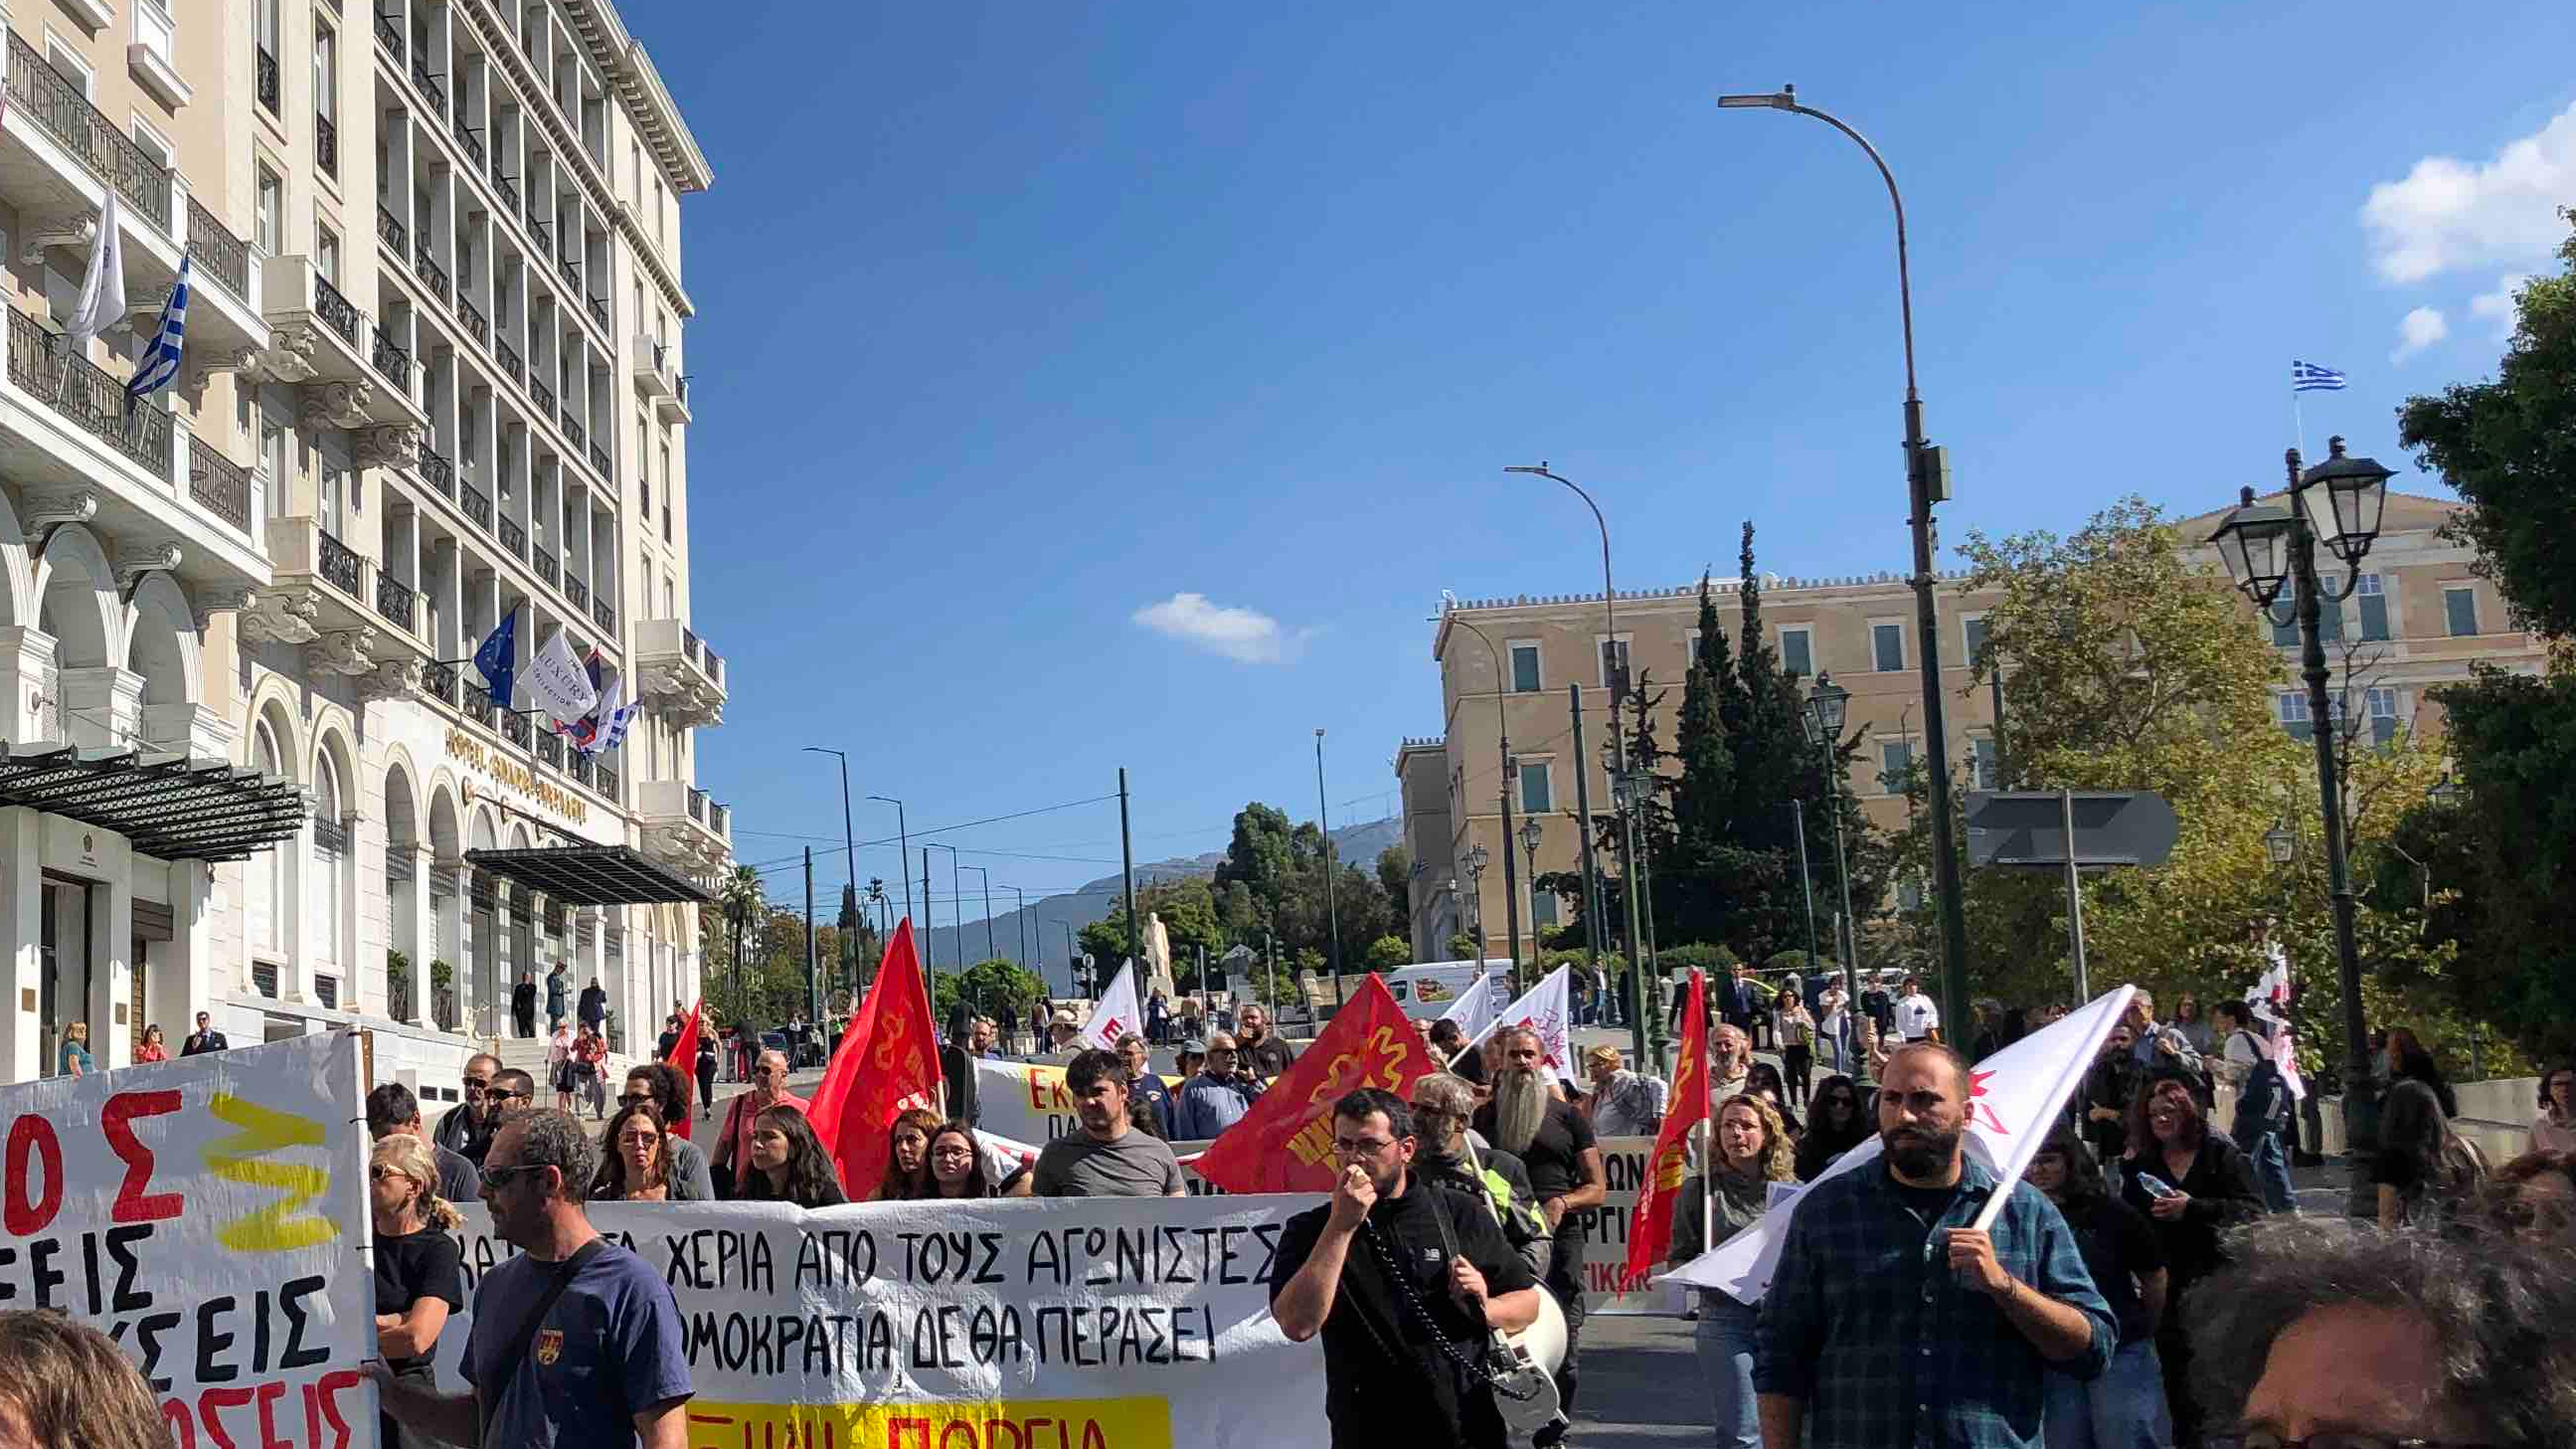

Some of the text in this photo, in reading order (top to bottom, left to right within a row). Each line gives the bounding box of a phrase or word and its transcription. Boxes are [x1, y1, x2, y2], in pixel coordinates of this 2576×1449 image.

[538, 651, 590, 702] LUXURY
[1599, 1153, 1645, 1191] ΩΝ
[665, 1229, 775, 1294] ΧΕΡΙΑ
[794, 1229, 877, 1292] ΑΠΟ
[896, 1230, 1005, 1285] ΤΟΥΣ
[1026, 1222, 1282, 1286] ΑΓΩΝΙΣΤΕΣ
[107, 1274, 332, 1394] ΣΕΙΣ
[1036, 1304, 1217, 1367] ΠΕΡΑΣΕΙ
